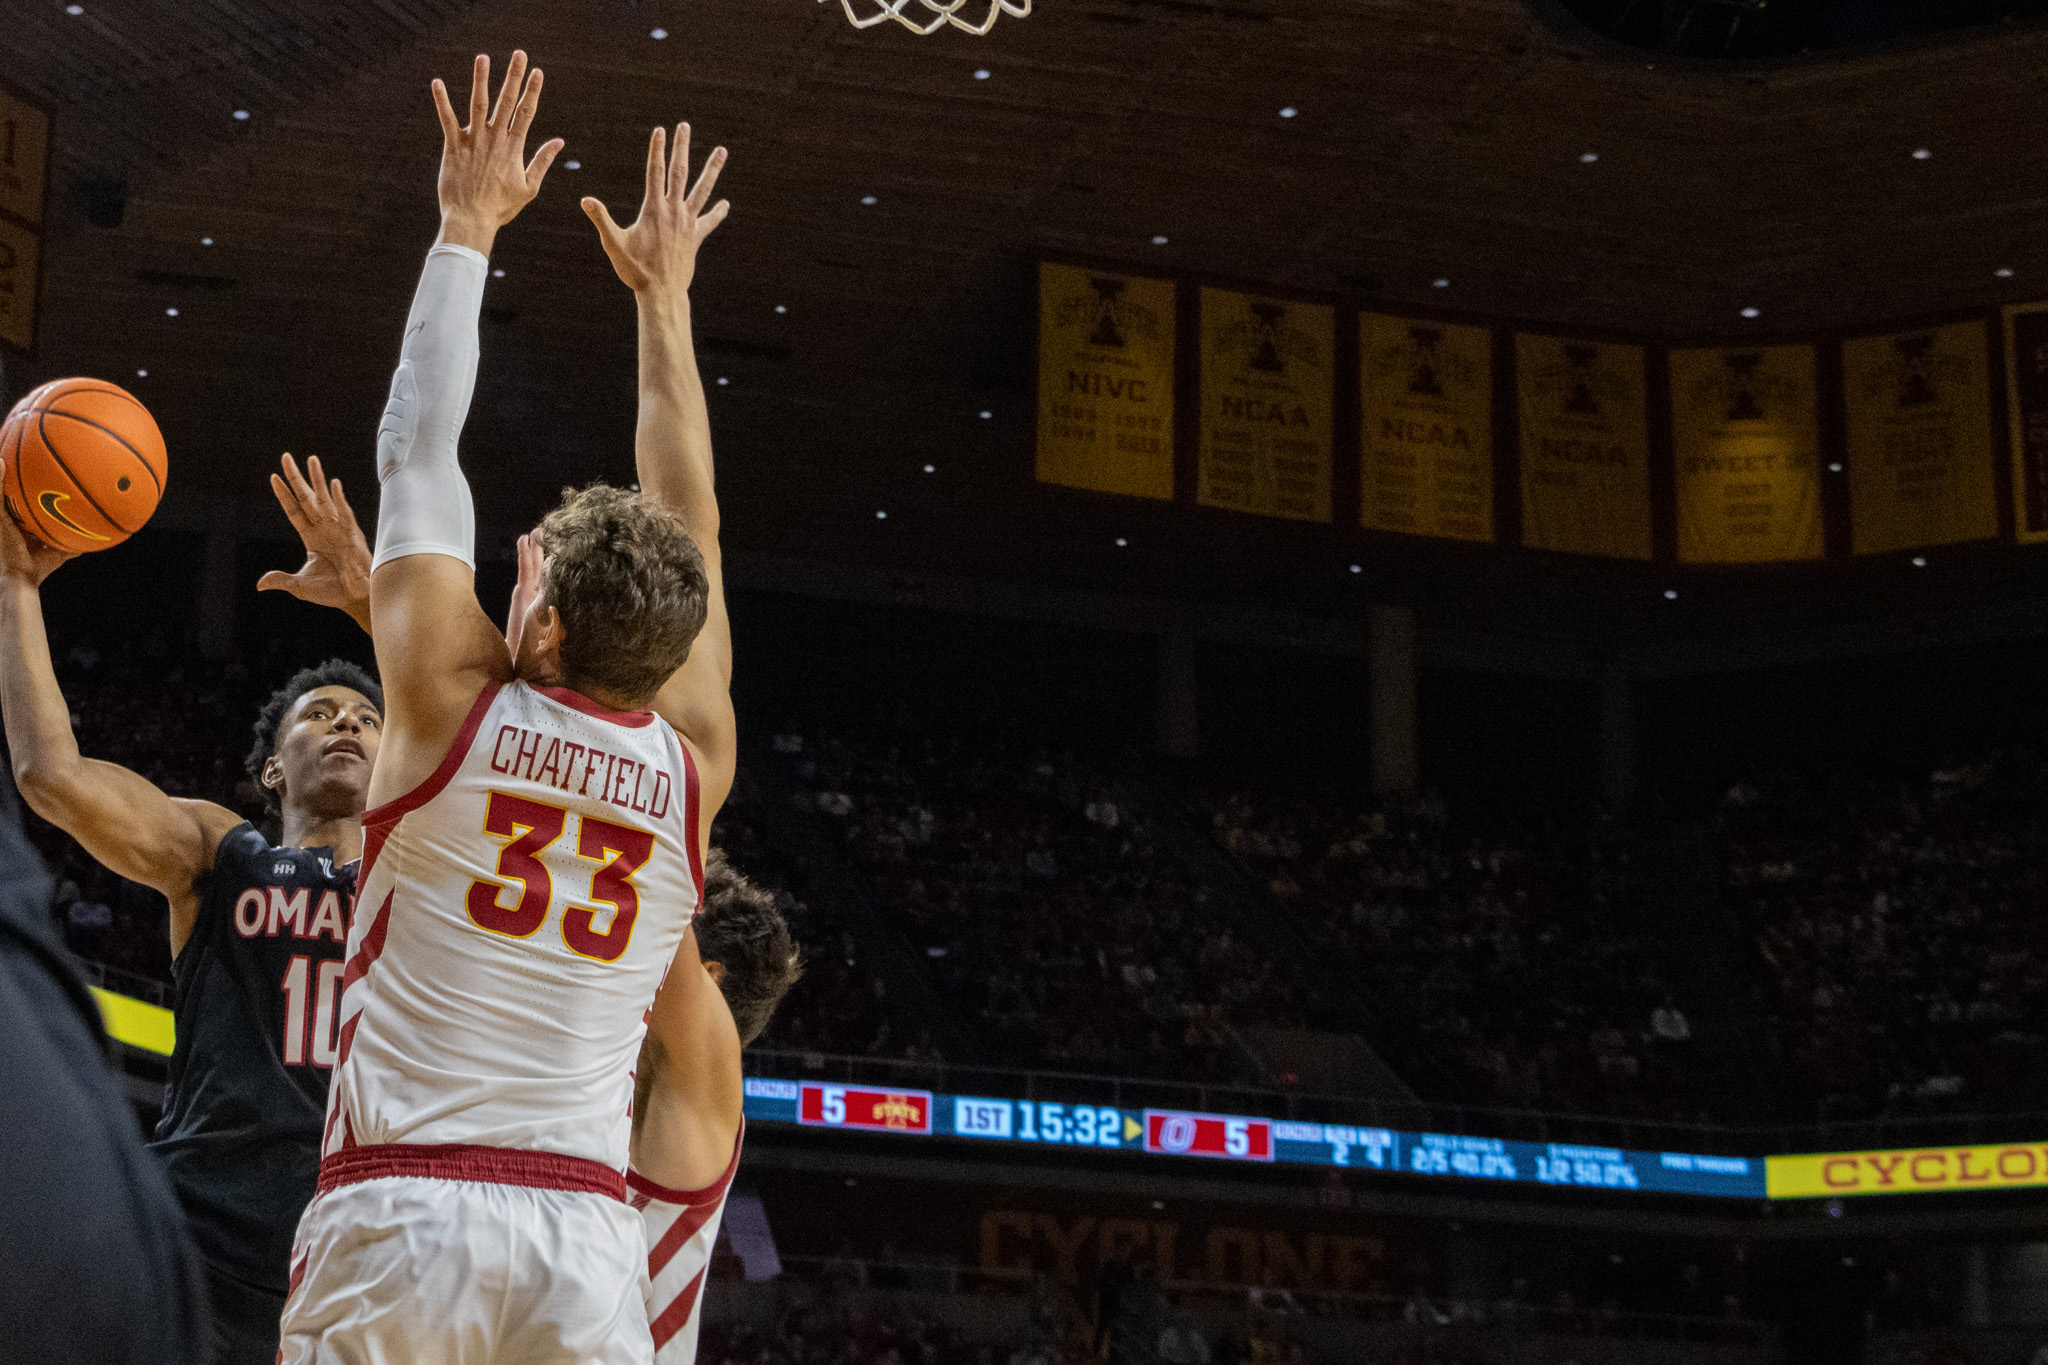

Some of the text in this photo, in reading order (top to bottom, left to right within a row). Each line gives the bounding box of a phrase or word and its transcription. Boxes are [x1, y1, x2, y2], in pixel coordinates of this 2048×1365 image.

[1066, 370, 1147, 403] NIVC
[1220, 395, 1310, 428] NCAA
[1380, 418, 1472, 451] NCAA
[491, 725, 672, 820] CHATFIELD
[273, 863, 297, 876] HH
[464, 789, 656, 964] 33
[234, 886, 356, 943] OMA
[281, 955, 345, 1068] 10
[822, 1086, 846, 1124] 5
[963, 1101, 1122, 1147] 1ST 15:32
[1224, 1118, 1250, 1157] 5
[1332, 1142, 1384, 1168] 2 4
[1822, 1145, 2048, 1189] CYCLO
